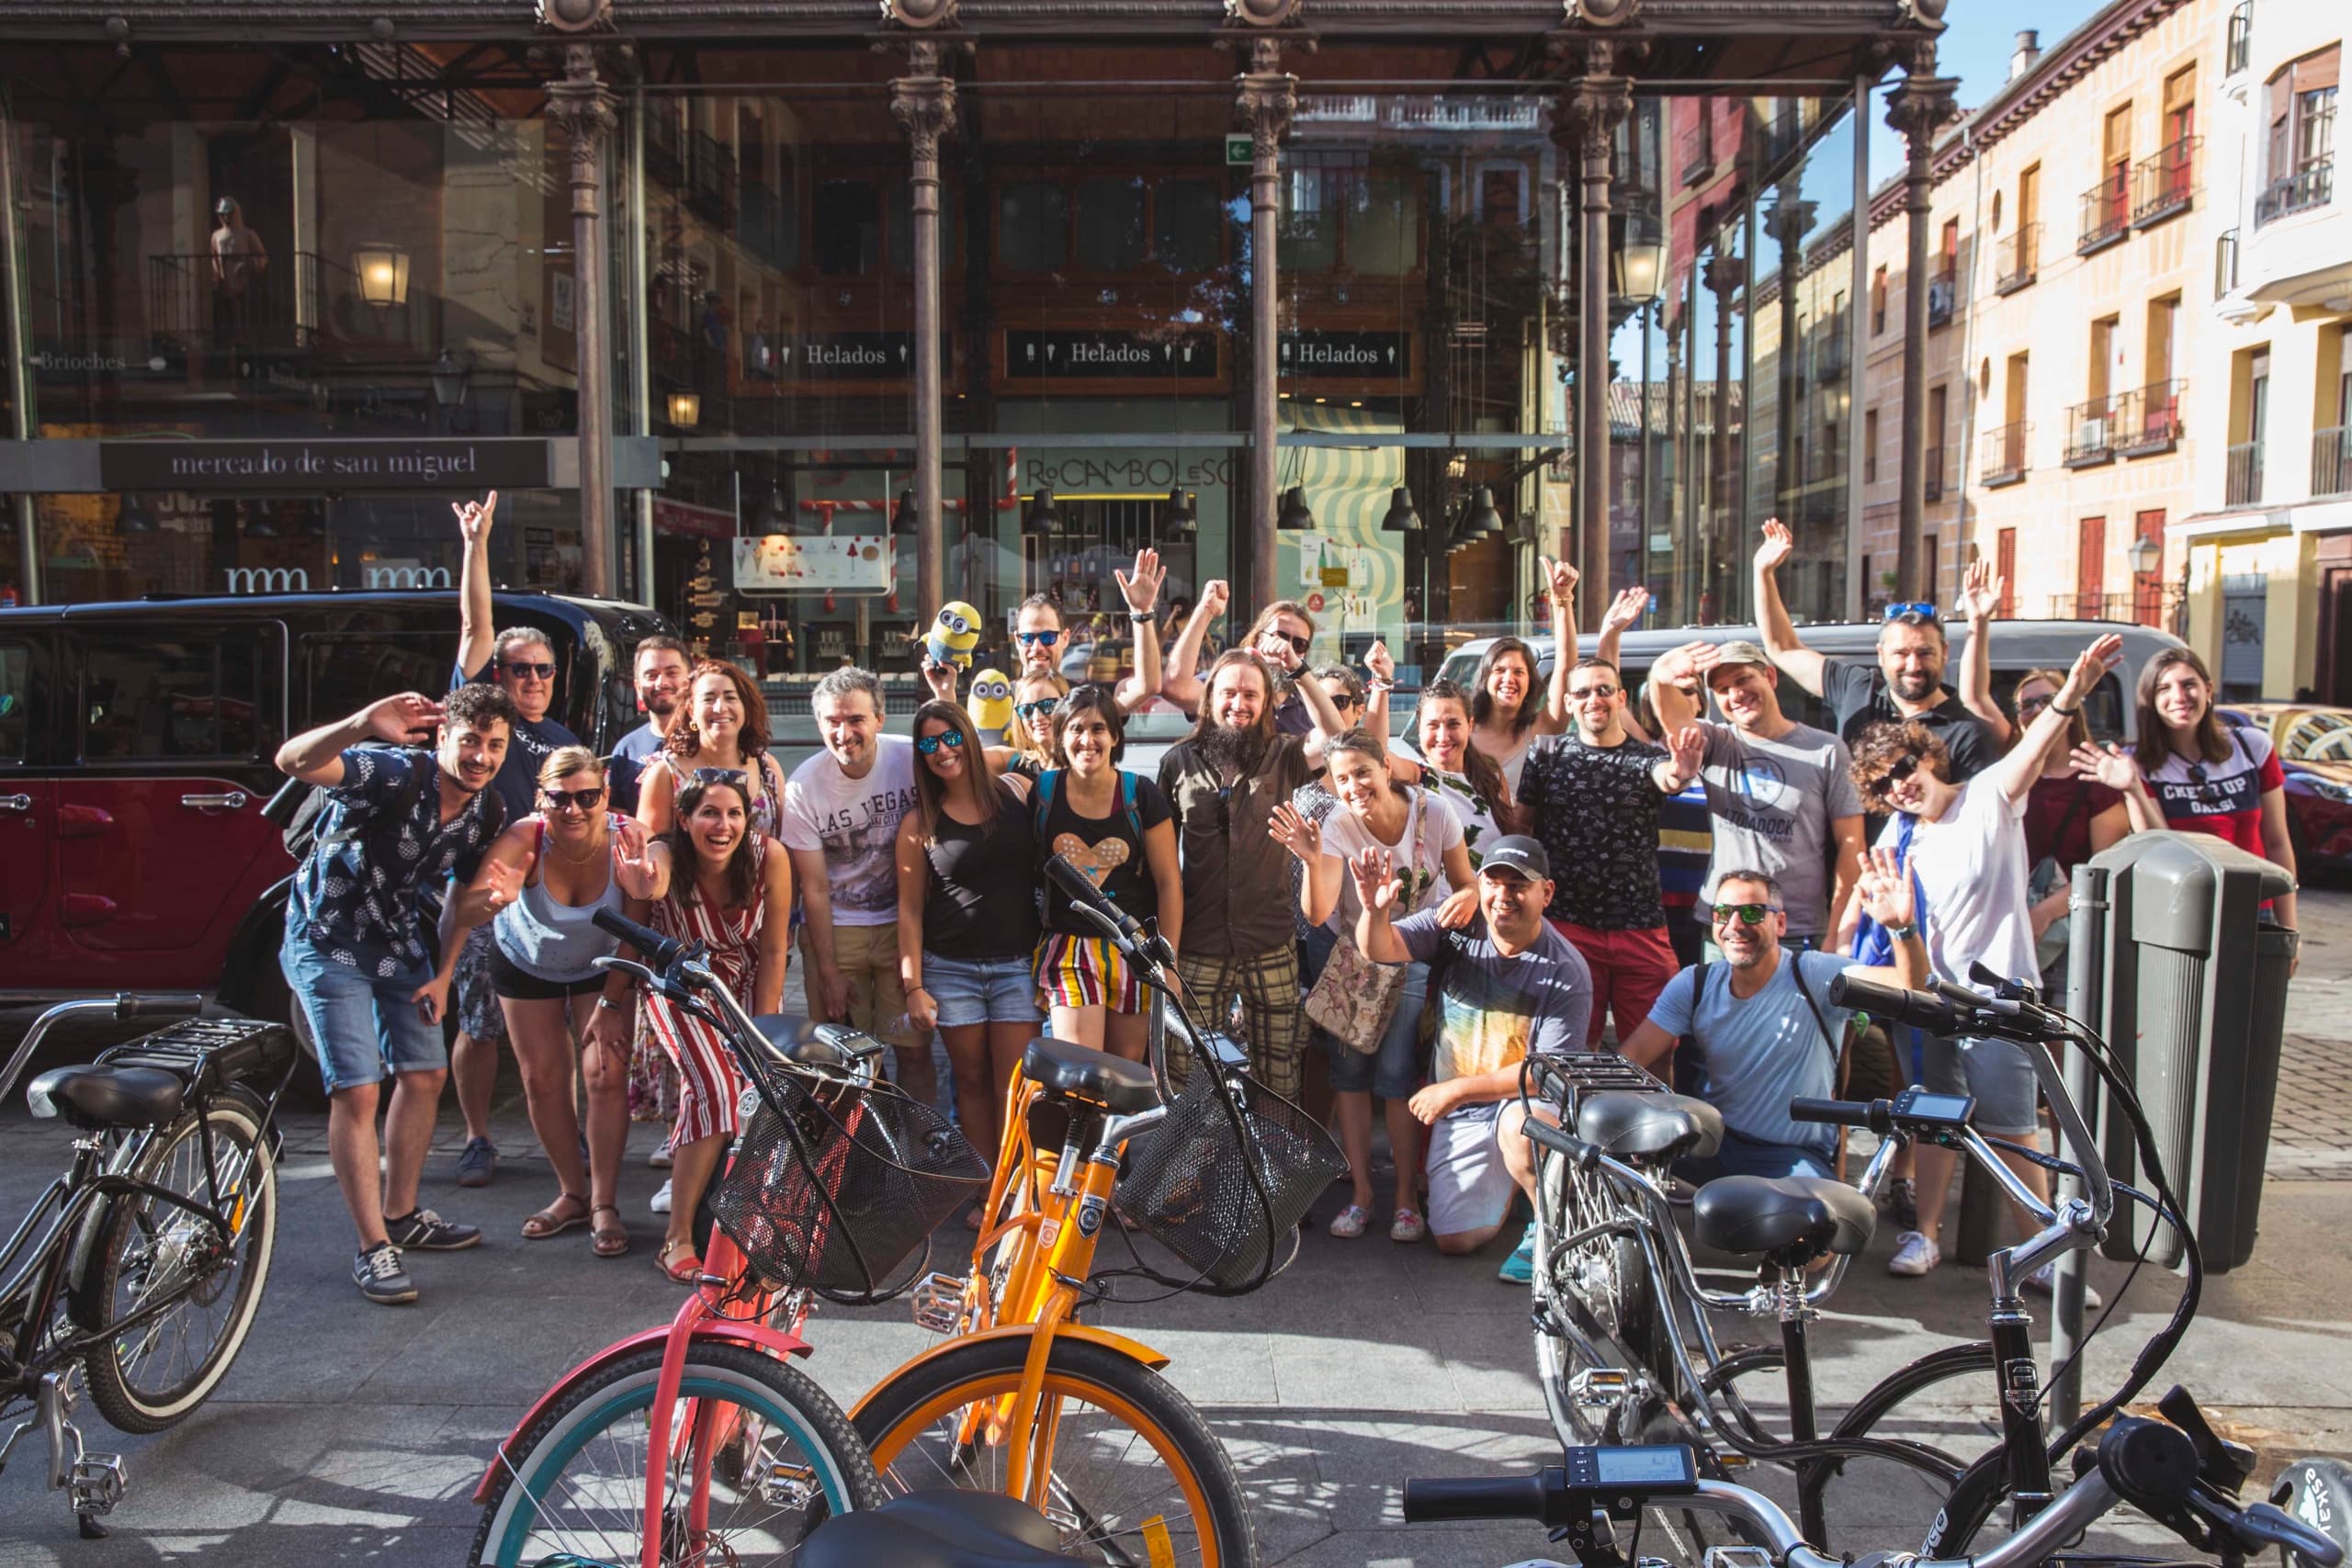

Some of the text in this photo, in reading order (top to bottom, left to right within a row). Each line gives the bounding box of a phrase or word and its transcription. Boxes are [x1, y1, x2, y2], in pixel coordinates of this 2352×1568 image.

[40, 351, 127, 370] Brioches
[807, 344, 887, 365] Helados
[1070, 343, 1151, 363] Helados
[1298, 343, 1378, 363] Helados
[172, 446, 476, 482] mercado de san miguel
[2222, 777, 2246, 795] UP
[816, 786, 920, 834] LAS VEGAS
